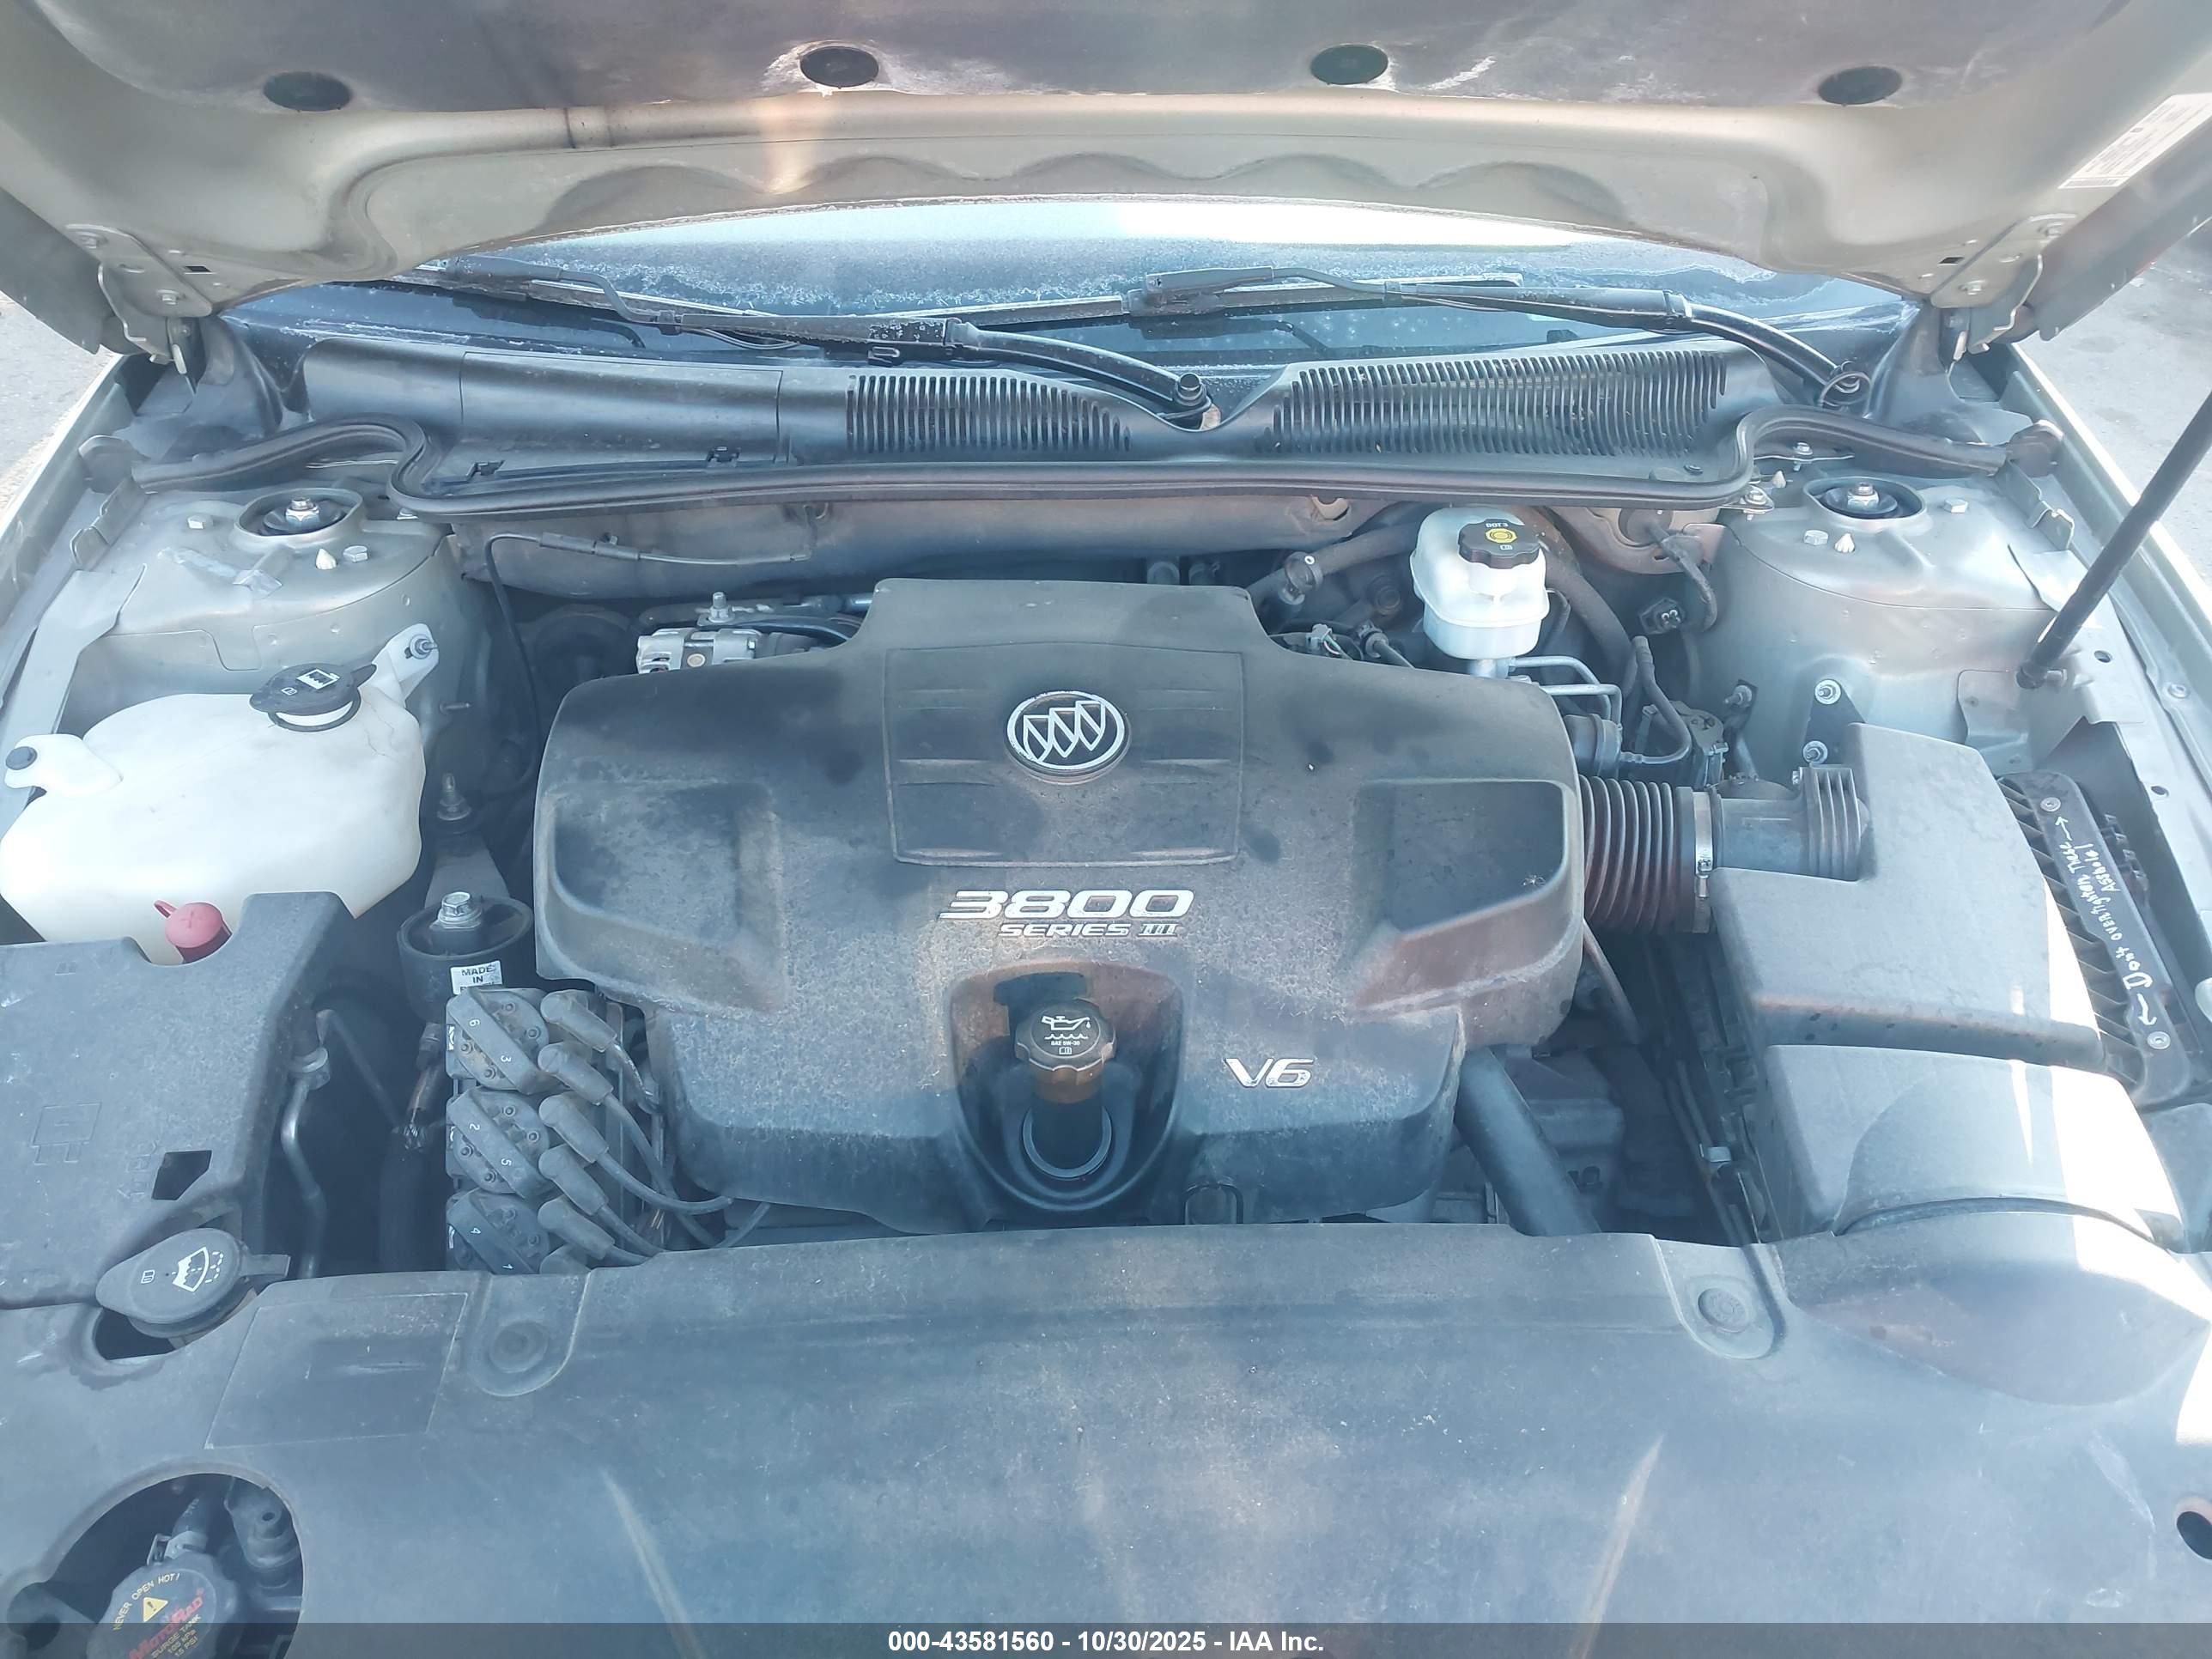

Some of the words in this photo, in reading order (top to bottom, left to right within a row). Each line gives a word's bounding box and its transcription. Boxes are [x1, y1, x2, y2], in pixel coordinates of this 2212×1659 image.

[939, 890, 1195, 919] 3800
[998, 923, 1132, 937] SERIES
[1138, 923, 1180, 937] III
[461, 965, 495, 976] MADE
[472, 975, 483, 984] IN
[469, 1018, 480, 1027] 6
[501, 1054, 512, 1063] 3
[1223, 1058, 1314, 1088] V6
[501, 1158, 512, 1166] 5
[112, 1601, 133, 1632] NEVER
[131, 1580, 155, 1601] OPEN
[158, 1571, 180, 1585] HOT!
[151, 1632, 181, 1659] SURGE
[179, 1613, 202, 1632] TANK
